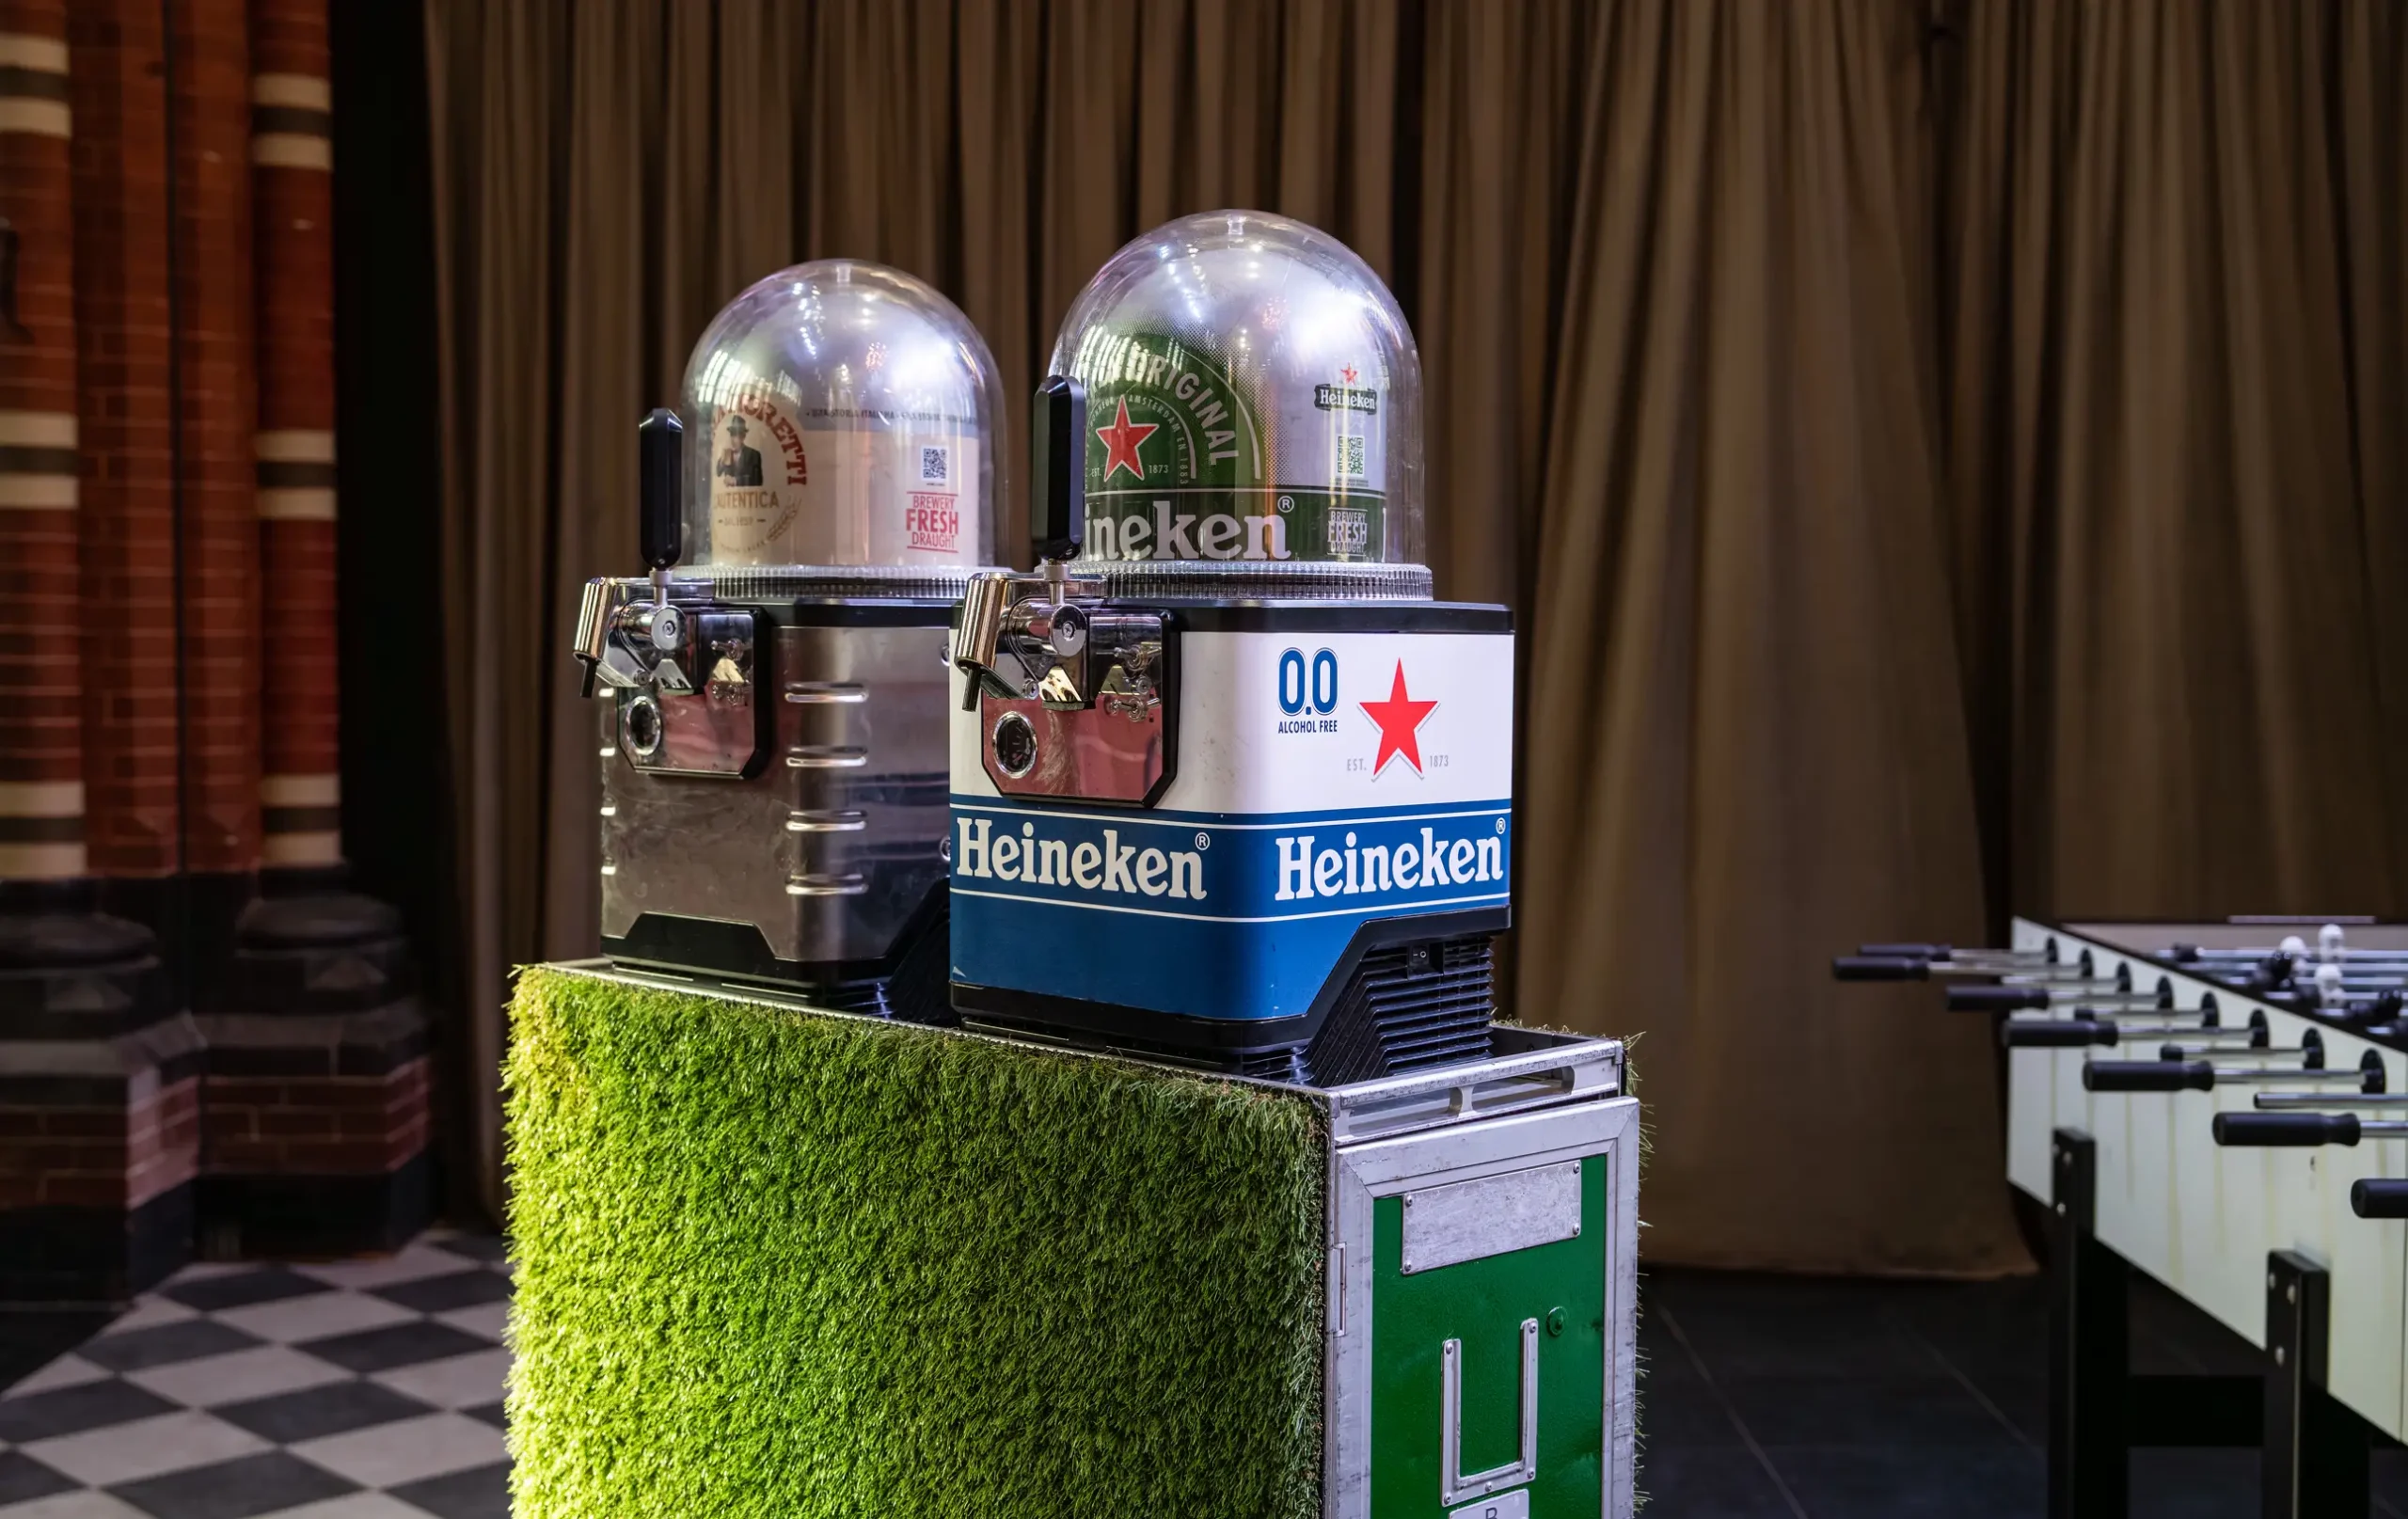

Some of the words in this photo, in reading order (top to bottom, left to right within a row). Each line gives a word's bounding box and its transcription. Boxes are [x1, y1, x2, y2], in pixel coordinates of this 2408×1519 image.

[1319, 388, 1376, 410] Heineken
[1129, 394, 1181, 433] AMSTERDAM
[1177, 436, 1187, 451] EN
[1149, 465, 1169, 474] 1873
[913, 495, 956, 510] BREWERY
[906, 508, 958, 535] FRESH
[1331, 511, 1367, 524] BREWERY
[911, 531, 956, 549] DRAUGHT
[1327, 521, 1368, 544] FRESH
[1330, 541, 1366, 553] DRAUGHT
[1278, 647, 1339, 717] 0.0
[1277, 720, 1317, 734] ALCOHOL
[1319, 720, 1339, 733] FREE
[1347, 758, 1368, 771] EST.
[1430, 755, 1450, 768] 1873
